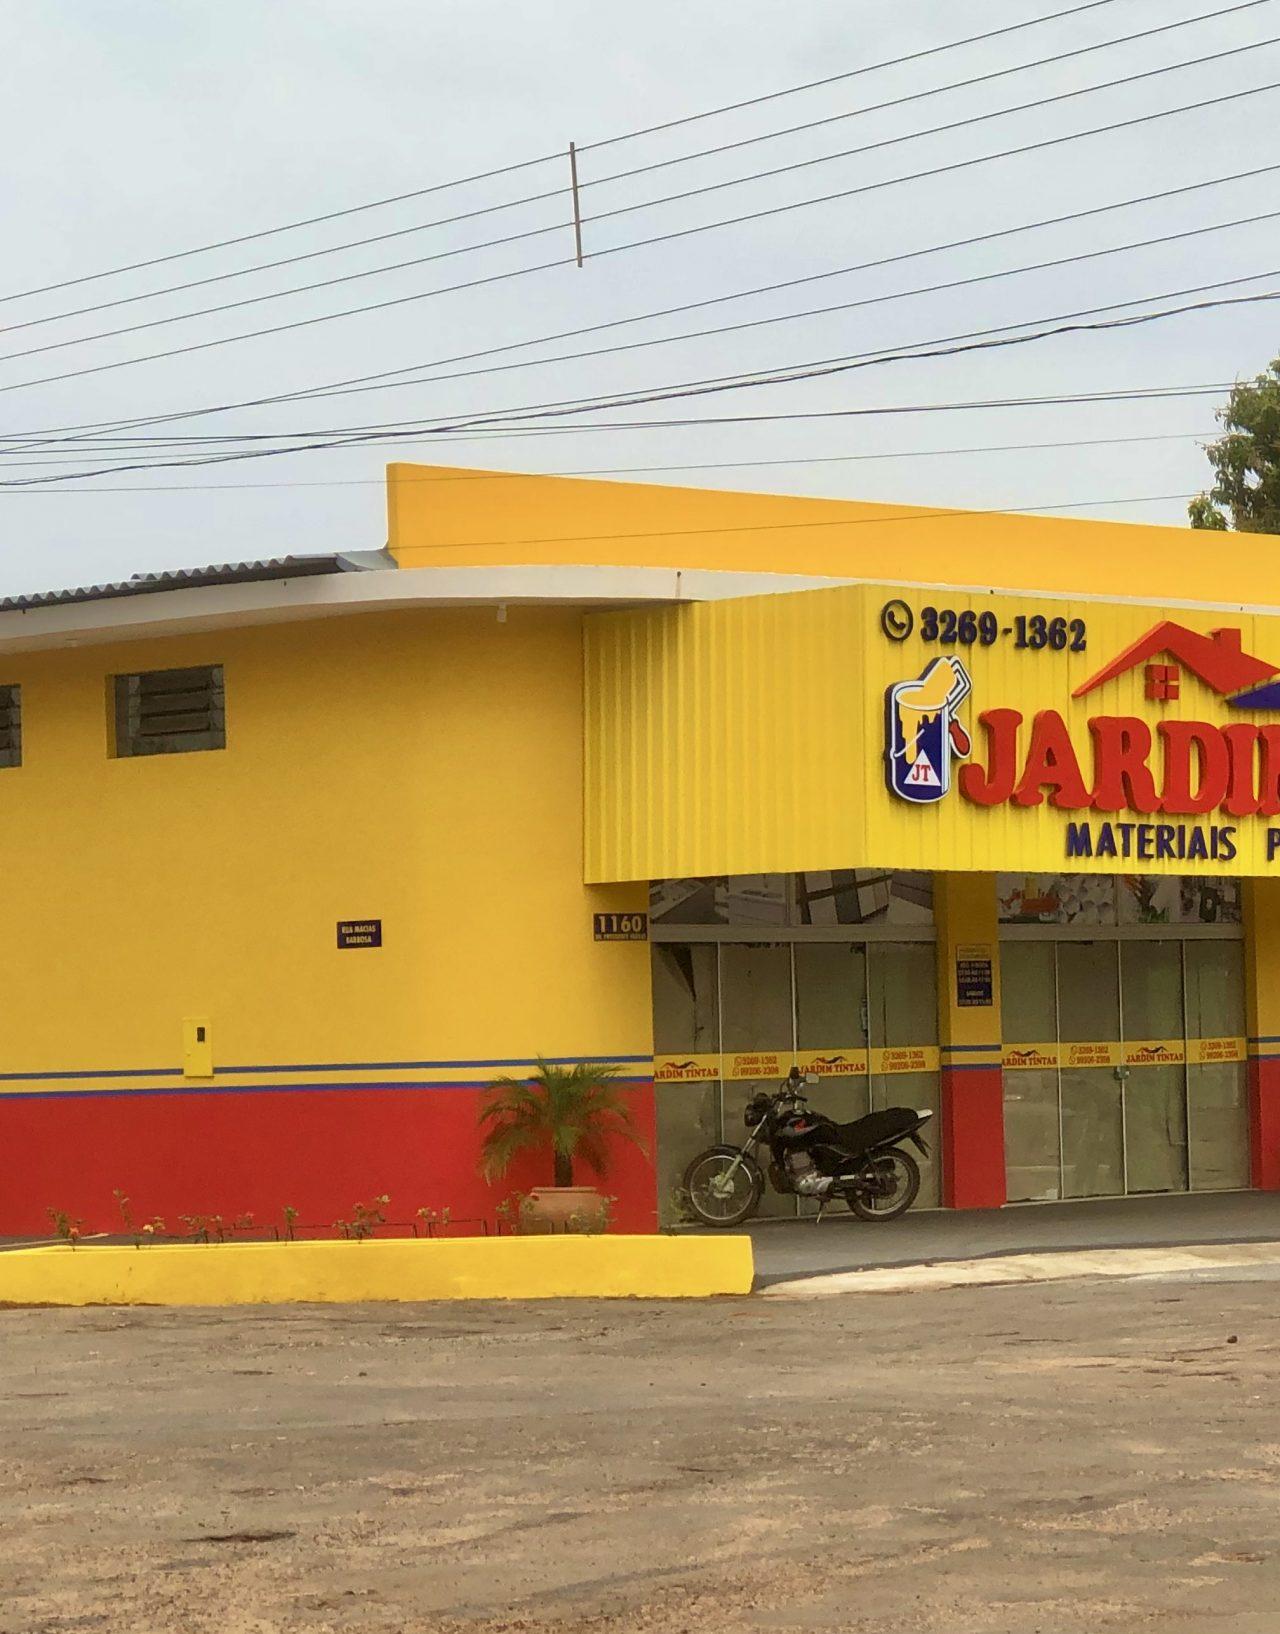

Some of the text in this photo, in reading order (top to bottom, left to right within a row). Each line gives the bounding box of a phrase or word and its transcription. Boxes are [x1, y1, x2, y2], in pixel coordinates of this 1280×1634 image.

[920, 606, 1087, 652] 3269-1362
[911, 764, 931, 782] JT
[1065, 822, 1237, 861] MATERIAIS
[598, 915, 642, 932] 1160
[1002, 1057, 1027, 1067] ARDIM
[654, 1069, 684, 1080] ARDIM
